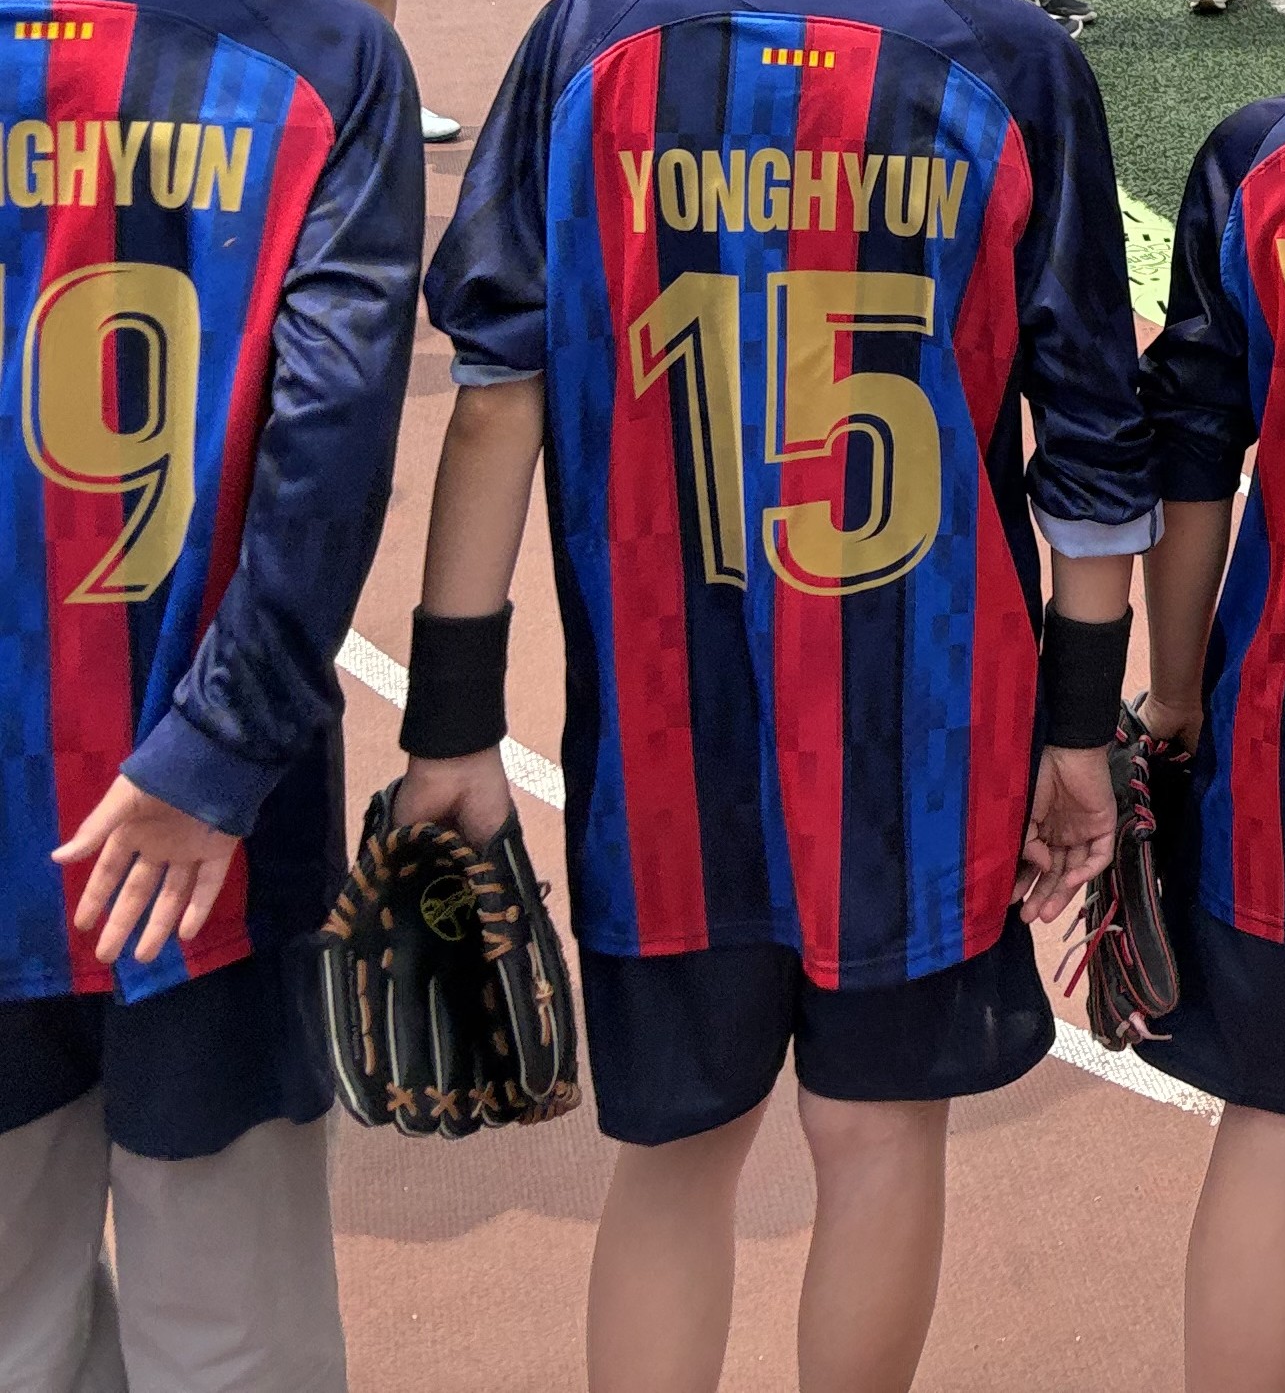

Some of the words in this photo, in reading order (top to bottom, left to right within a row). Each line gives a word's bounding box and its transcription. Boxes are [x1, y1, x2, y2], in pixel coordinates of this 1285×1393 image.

[0, 119, 254, 212] GHYUN
[618, 147, 970, 240] YONGHYUN
[0, 261, 200, 605] 9
[628, 269, 942, 597] 15
